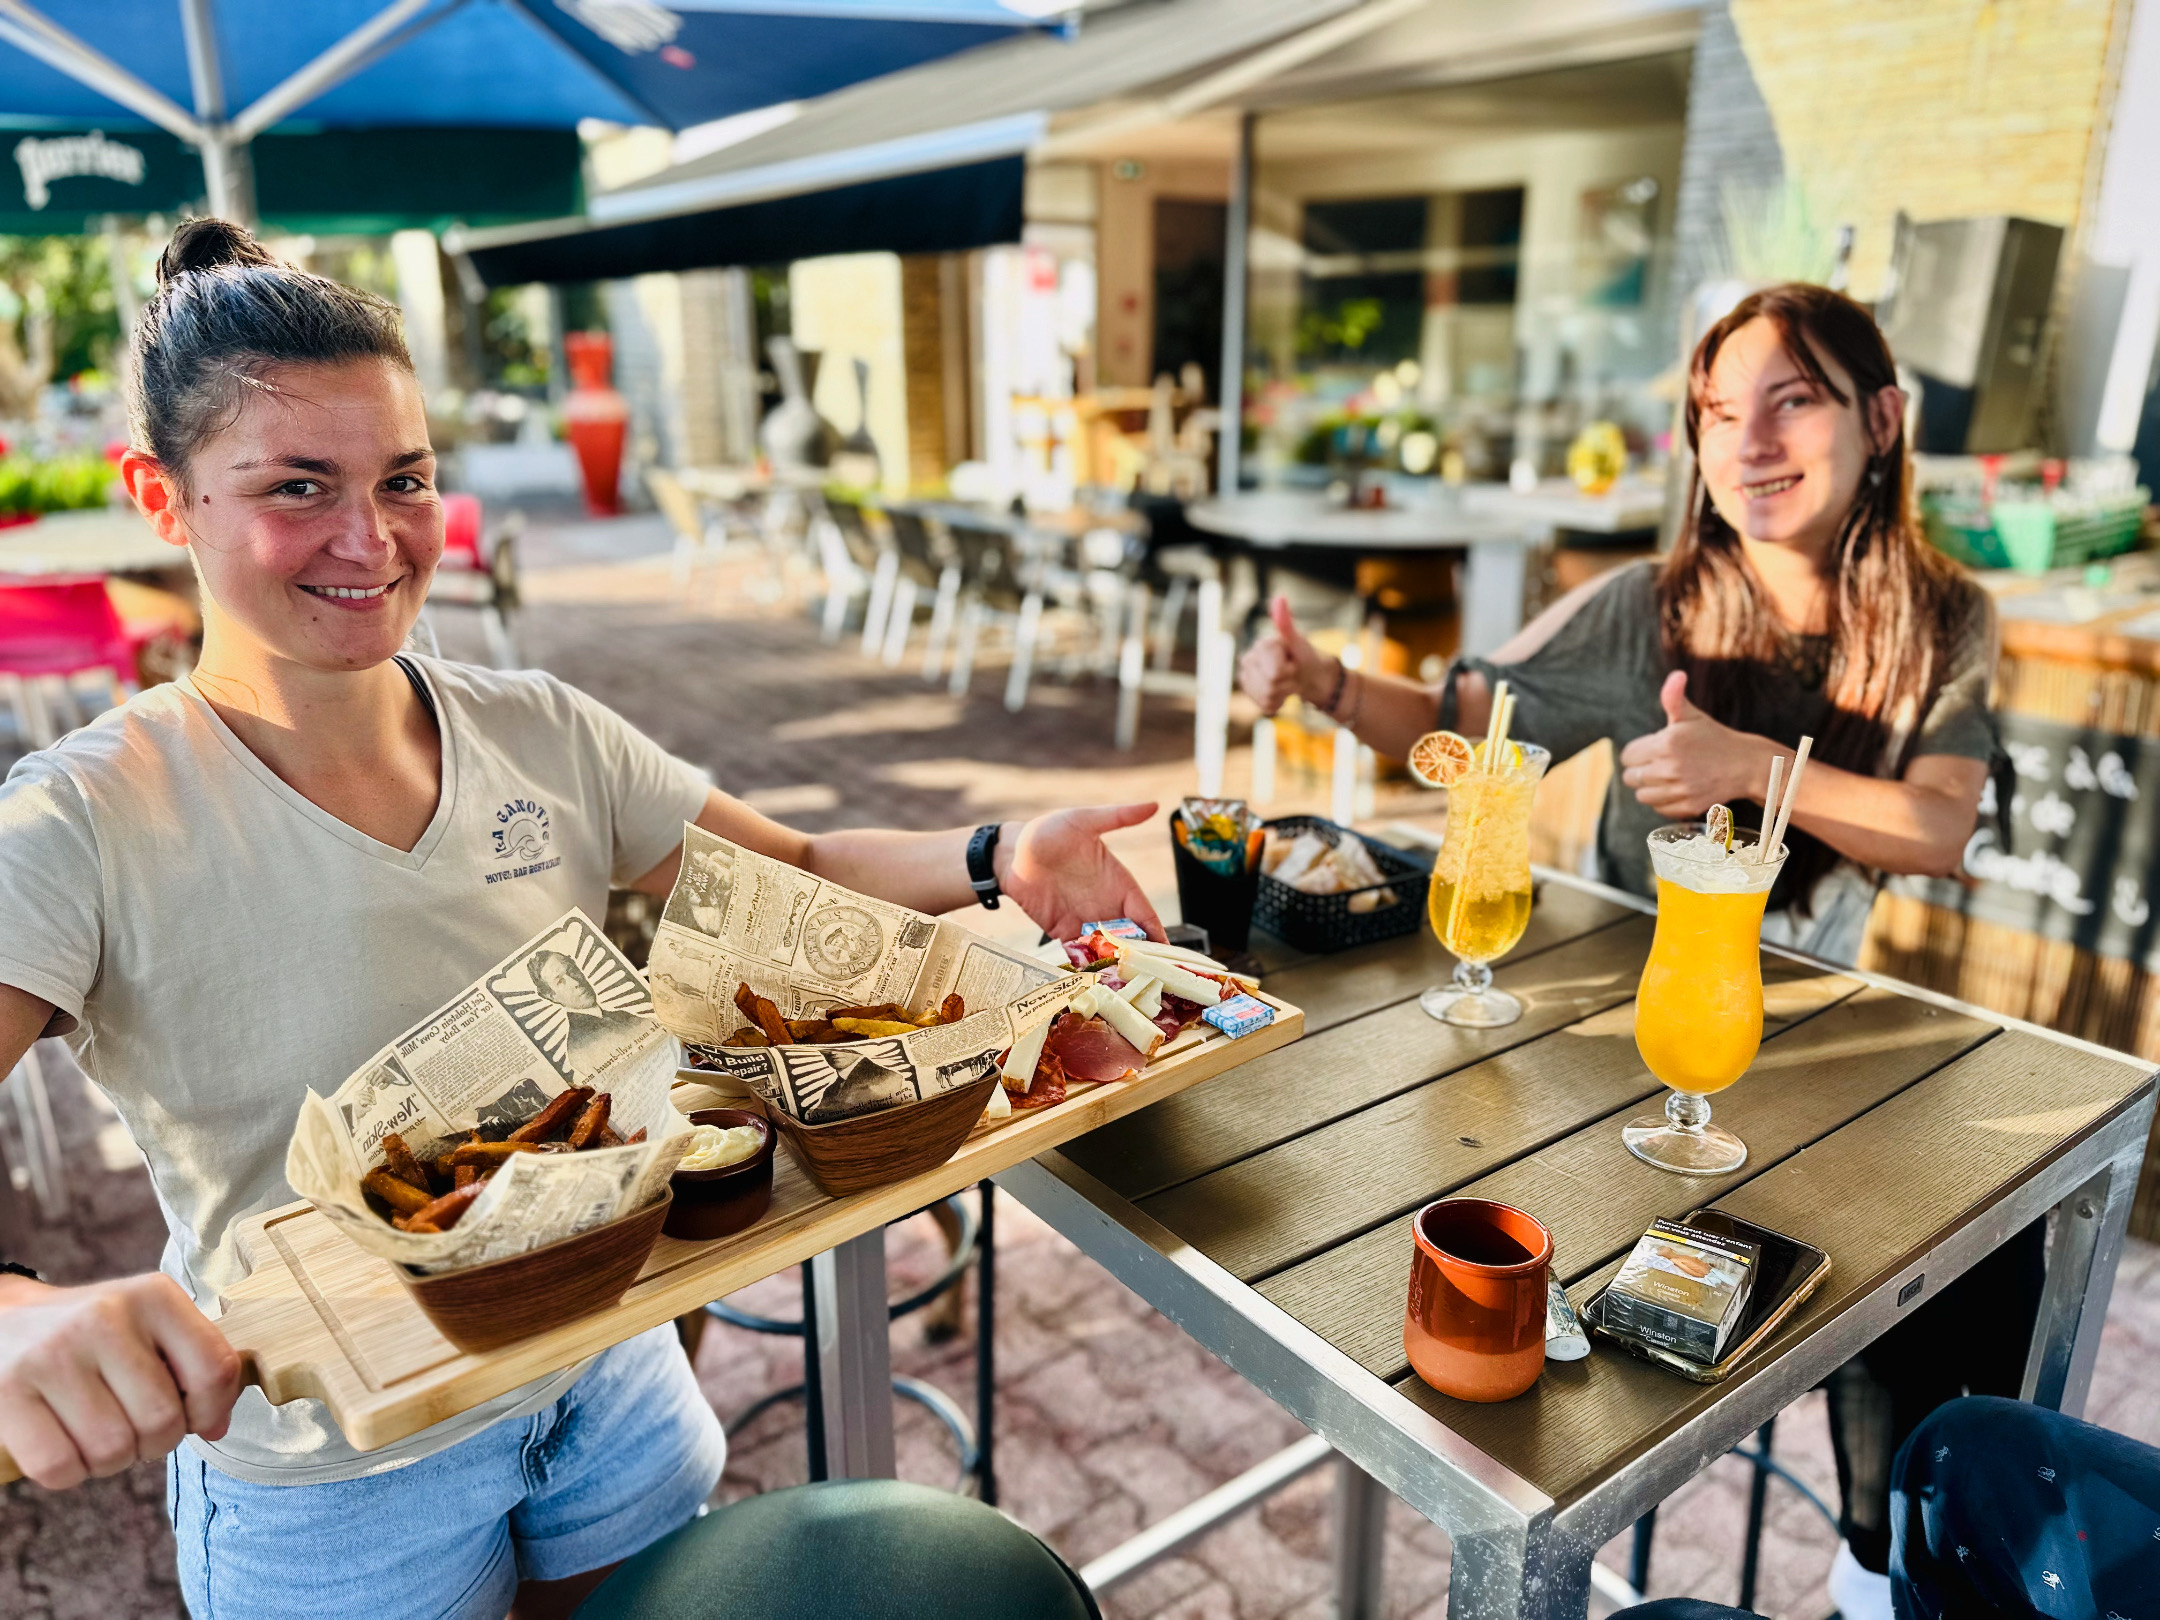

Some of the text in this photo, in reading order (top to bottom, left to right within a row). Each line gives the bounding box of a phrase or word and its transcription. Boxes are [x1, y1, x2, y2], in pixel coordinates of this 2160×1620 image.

[725, 1055, 765, 1066] Build
[1653, 1281, 1690, 1297] Winston
[1640, 1325, 1677, 1344] Winston
